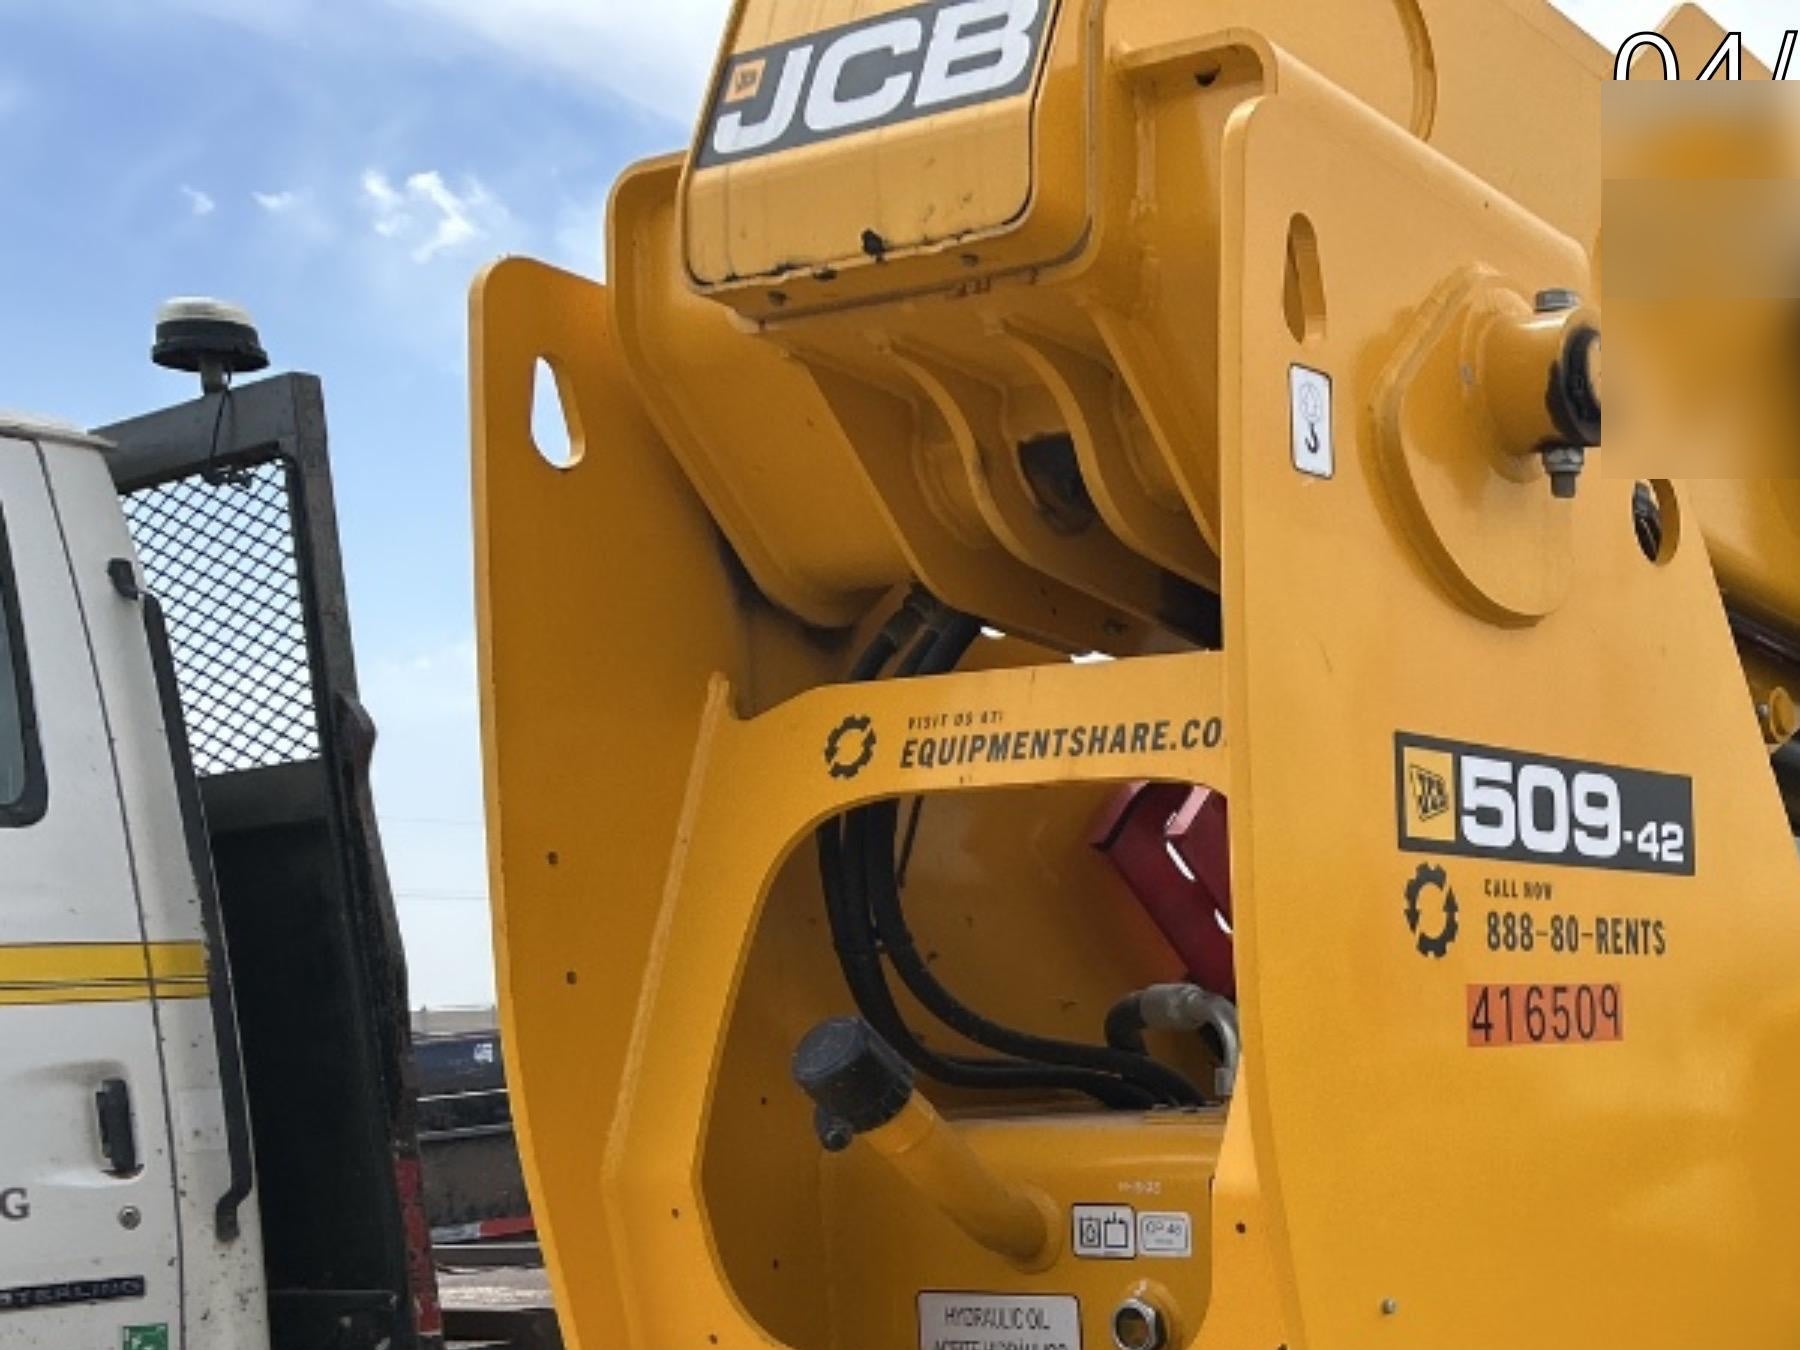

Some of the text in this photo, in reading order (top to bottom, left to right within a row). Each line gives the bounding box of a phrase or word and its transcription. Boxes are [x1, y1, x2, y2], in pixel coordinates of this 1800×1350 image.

[712, 0, 1038, 154] JCB
[1484, 878, 1552, 900] CALL NOW
[1486, 910, 1666, 956] 888-80-RENTS
[1470, 984, 1621, 1042] 416509
[944, 1306, 1051, 1331] HYDRAULIC OIL
